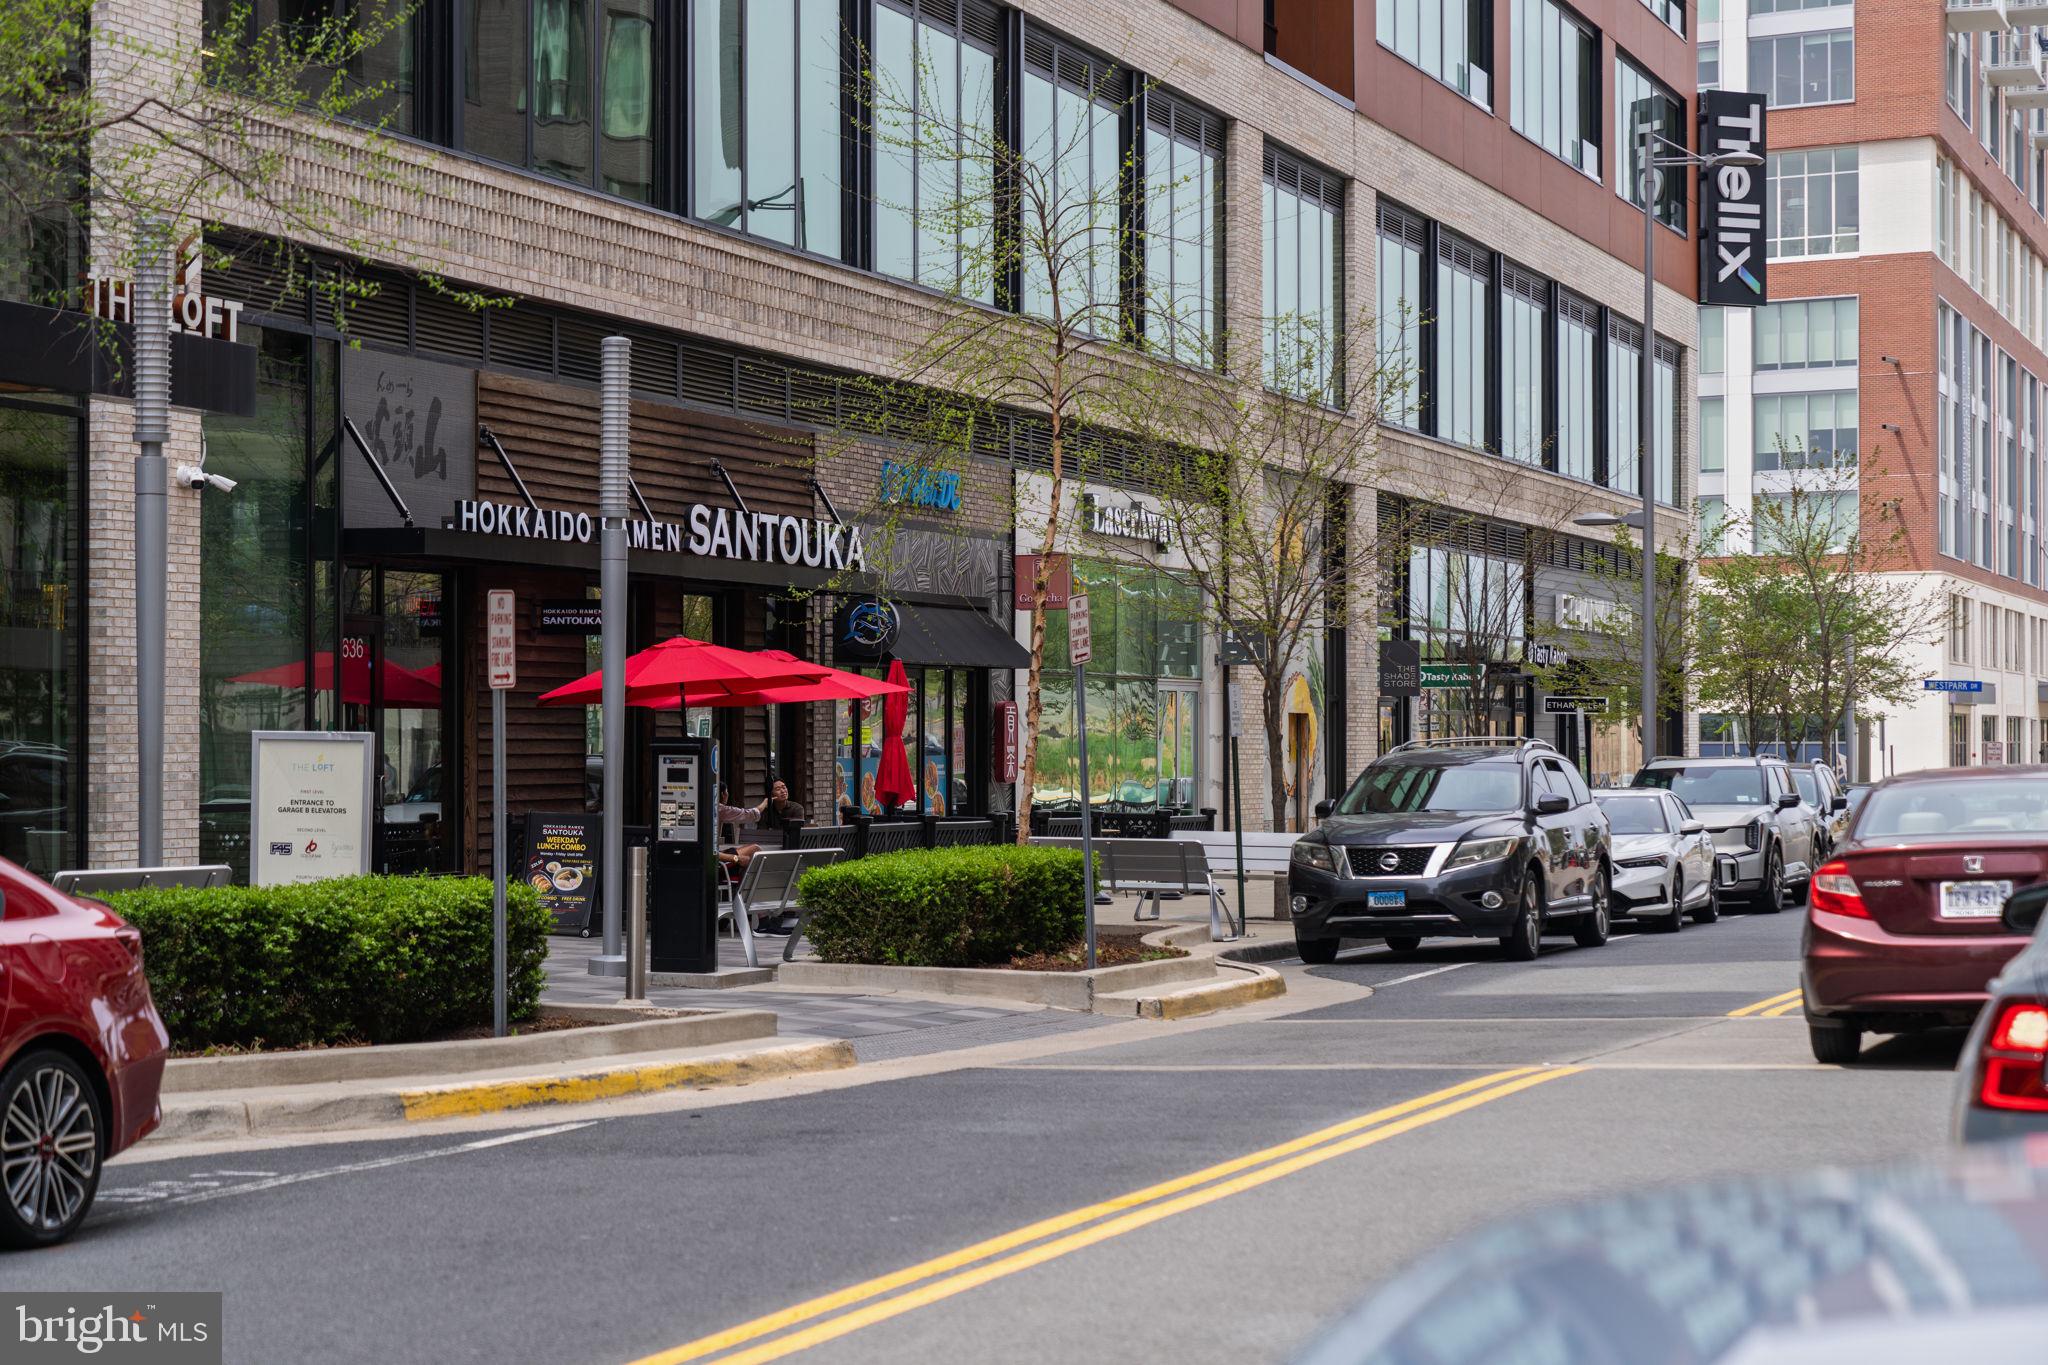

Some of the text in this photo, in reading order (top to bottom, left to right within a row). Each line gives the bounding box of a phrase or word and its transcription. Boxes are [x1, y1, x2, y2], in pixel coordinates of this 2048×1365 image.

[1717, 104, 1760, 294] Trellix
[87, 272, 131, 324] TH
[461, 500, 680, 552] HOKKAIDO AMEN
[690, 504, 866, 572] SANTOUKA
[1070, 608, 1088, 620] PARKING
[543, 616, 602, 625] SANTOUKA
[1071, 627, 1088, 638] STANDING
[342, 638, 363, 658] 636
[1397, 665, 1416, 673] THE
[1425, 672, 1451, 683] Tasty
[1384, 680, 1417, 688] STORE
[1928, 682, 1967, 690] WESTPARK
[1546, 702, 1575, 710] ETHAN
[293, 763, 334, 772] THE LOFT
[546, 836, 579, 844] WEEKDAY
[271, 843, 291, 854] F45
[536, 842, 586, 851] LUNCH COMBO
